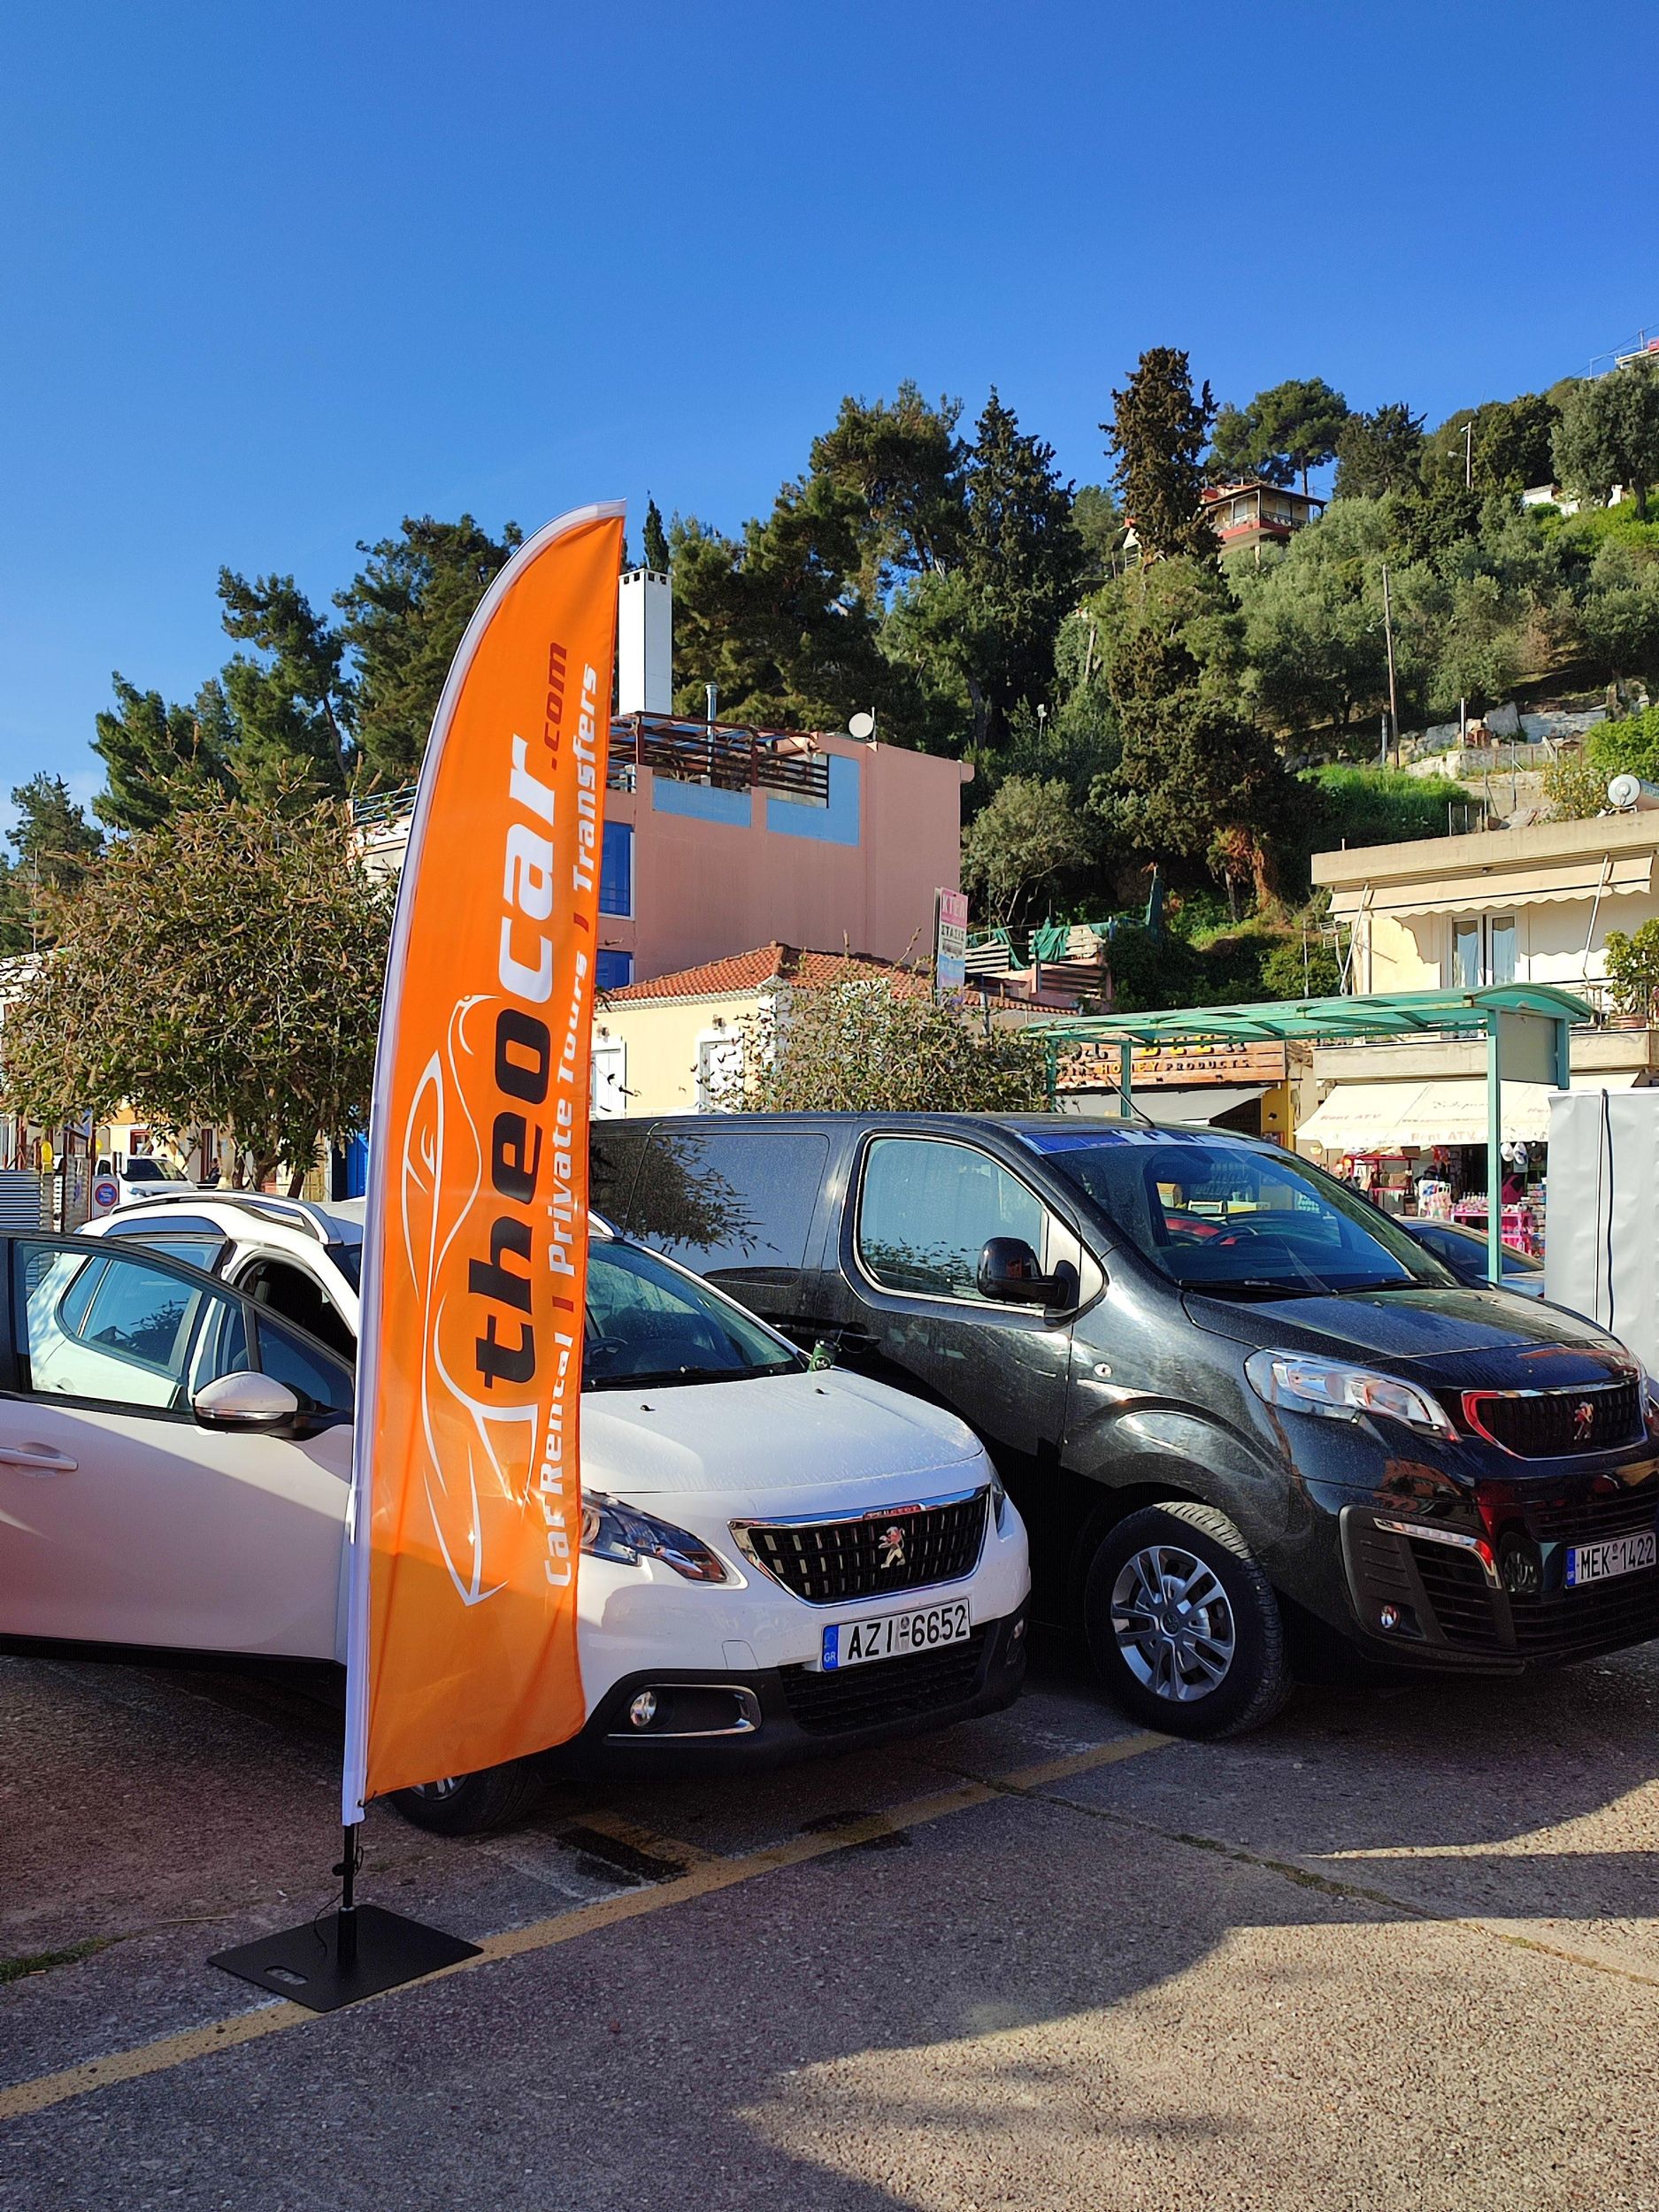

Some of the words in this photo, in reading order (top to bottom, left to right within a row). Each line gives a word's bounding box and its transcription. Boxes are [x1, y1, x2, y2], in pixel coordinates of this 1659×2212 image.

[572, 663, 596, 894] Transfers
[557, 949, 587, 1086] Tours
[1101, 1062, 1160, 1076] HOEY
[1166, 1059, 1250, 1071] PRODUCTS
[548, 1098, 575, 1277] Private
[1411, 1133, 1441, 1143] Rent
[1448, 1131, 1477, 1142] ATV
[540, 1332, 574, 1495] Rental
[544, 1505, 572, 1586] Car
[824, 1651, 836, 1663] GR
